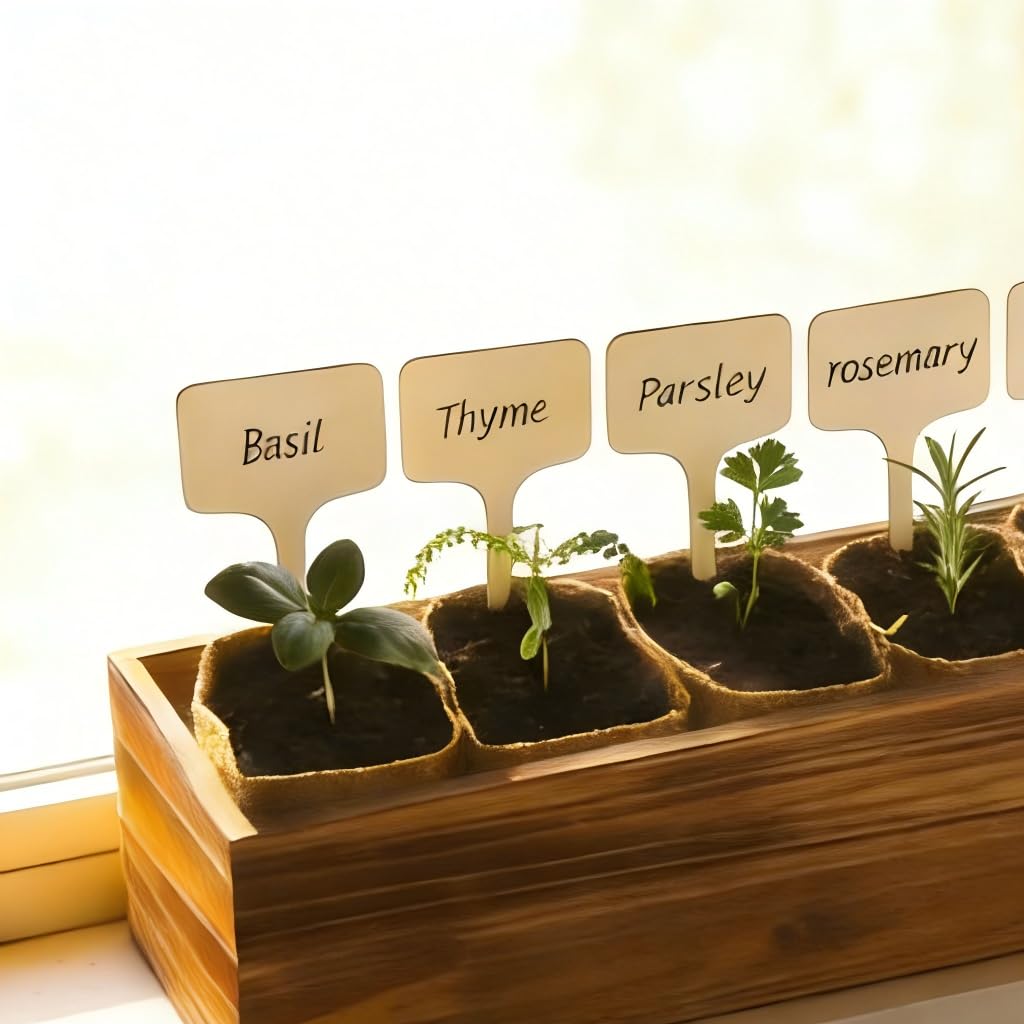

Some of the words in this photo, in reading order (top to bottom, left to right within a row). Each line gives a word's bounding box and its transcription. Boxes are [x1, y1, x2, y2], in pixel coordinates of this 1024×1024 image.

[827, 337, 978, 389] rosemary
[638, 363, 767, 412] Parsley
[241, 418, 324, 466] Basil
[436, 399, 550, 441] Thyme
